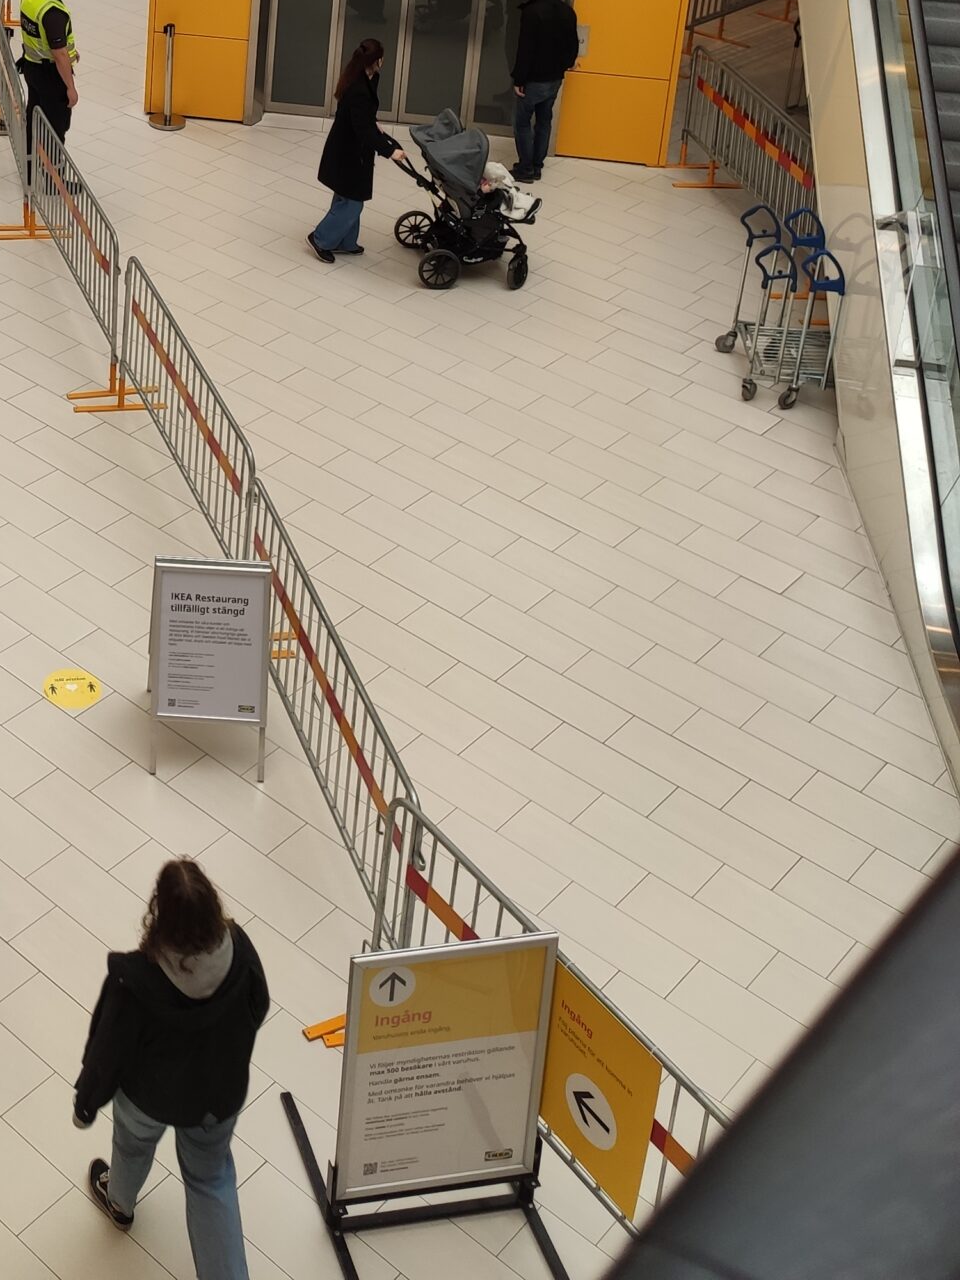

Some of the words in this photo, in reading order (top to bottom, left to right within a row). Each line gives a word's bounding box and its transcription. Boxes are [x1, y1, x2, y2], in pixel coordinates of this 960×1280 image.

[171, 592, 192, 601] IKEA
[195, 594, 249, 606] Restaurang
[170, 604, 210, 615] tillfälligt
[212, 606, 245, 617] stängd
[375, 1009, 432, 1028] Ingång
[561, 1000, 593, 1040] Ingång
[401, 1063, 433, 1072] besökare
[393, 1075, 415, 1084] gärna
